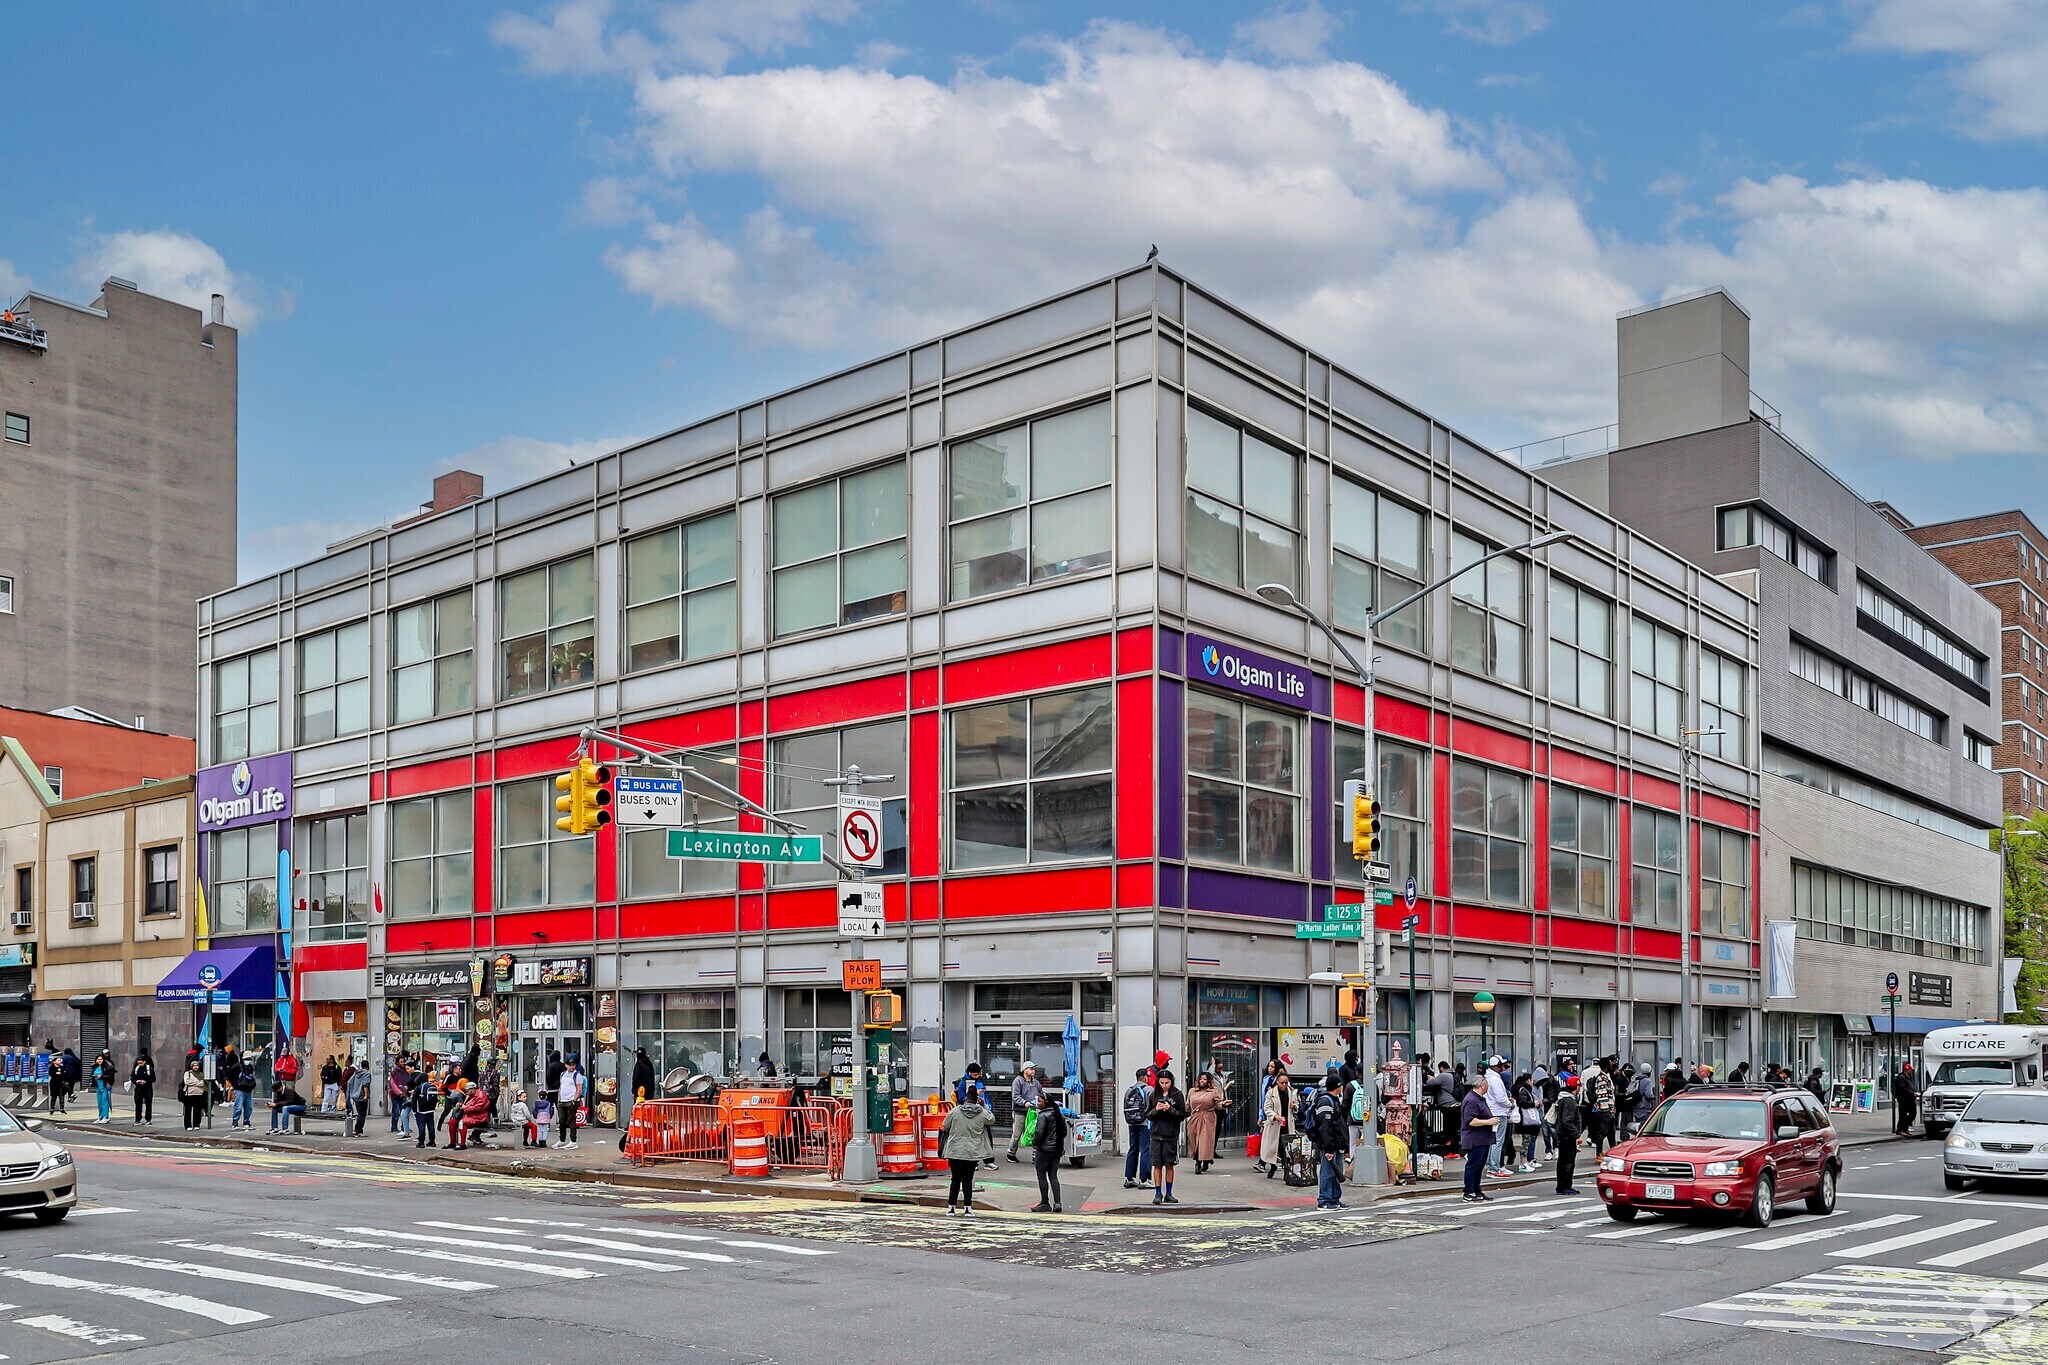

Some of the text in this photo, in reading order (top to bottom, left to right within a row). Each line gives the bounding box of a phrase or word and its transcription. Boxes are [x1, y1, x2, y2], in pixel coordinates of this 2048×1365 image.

[1222, 655, 1305, 698] Olgam Life
[633, 781, 678, 791] BUS LANE
[620, 794, 678, 806] BUSES ONLY
[866, 799, 880, 808] BUSES
[200, 786, 285, 826] Olgam Life
[682, 836, 804, 859] Lexington Av
[1365, 866, 1388, 878] ONE WAY
[863, 891, 882, 900] TRUCK
[863, 904, 882, 913] ROUTE
[1328, 907, 1333, 919] E
[1336, 906, 1351, 919] 125
[843, 923, 867, 932] LOCAL
[1297, 922, 1362, 933] Dr Martin Luther King Jr
[552, 960, 577, 968] HARLEM
[849, 964, 875, 973] RAISE
[412, 972, 432, 986] Salad
[431, 972, 438, 985] &
[454, 970, 469, 984] Bar
[514, 962, 541, 986] DELI
[850, 976, 874, 985] PLOW
[157, 989, 176, 998] PLASMA
[1206, 987, 1225, 998] HOW
[439, 1014, 457, 1028] OPEN
[531, 1014, 557, 1030] OPEN
[1942, 1040, 2006, 1050] CITICARE
[832, 1046, 852, 1055] AVAIL
[1556, 1048, 1578, 1056] AVAILABLE
[752, 1096, 776, 1105] WANCO
